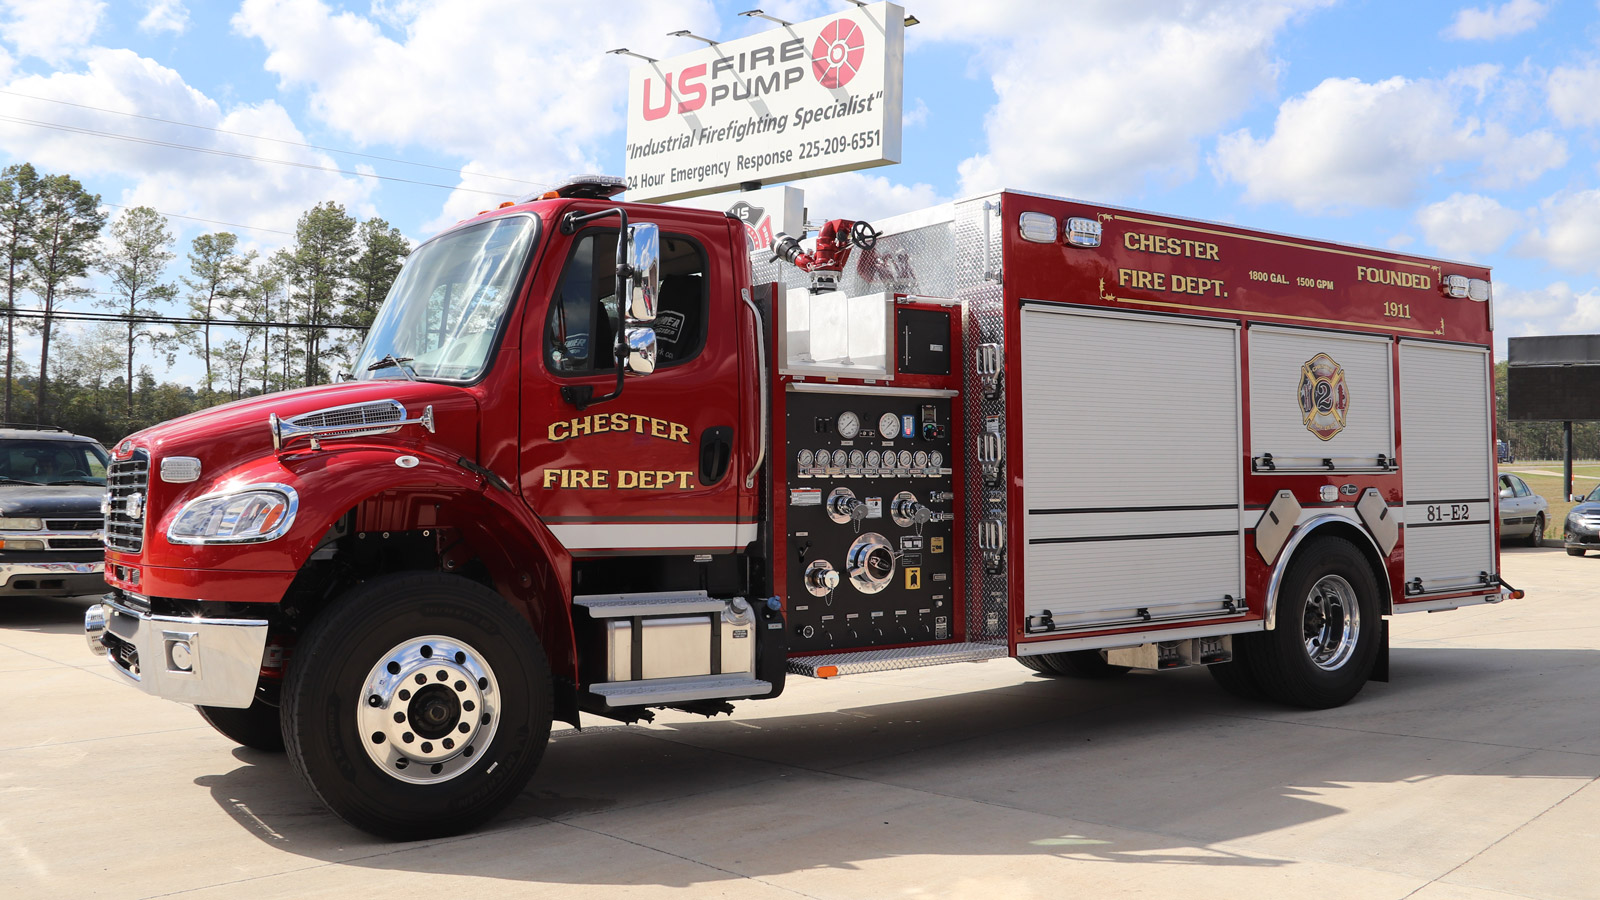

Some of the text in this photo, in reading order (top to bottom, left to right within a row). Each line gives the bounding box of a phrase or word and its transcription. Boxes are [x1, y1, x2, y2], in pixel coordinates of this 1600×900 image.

[712, 37, 805, 80] FIRE
[643, 63, 707, 121] US
[711, 66, 805, 107] PUMP
[698, 113, 788, 146] Firefighting
[627, 130, 881, 191] 24 Hour Emergency Response 225-209-6551
[1124, 232, 1220, 262] CHESTER
[1118, 268, 1229, 299] FIRE DEPT.
[1248, 270, 1334, 291] 1800 GAL. 1500 GPM
[1357, 265, 1432, 291] FOUNDED
[1383, 301, 1411, 319] 1911
[1316, 381, 1333, 410] 2
[547, 412, 690, 444] CHESTER
[543, 469, 695, 490] FIRE DEPT.
[1427, 504, 1470, 522] 81-E2
